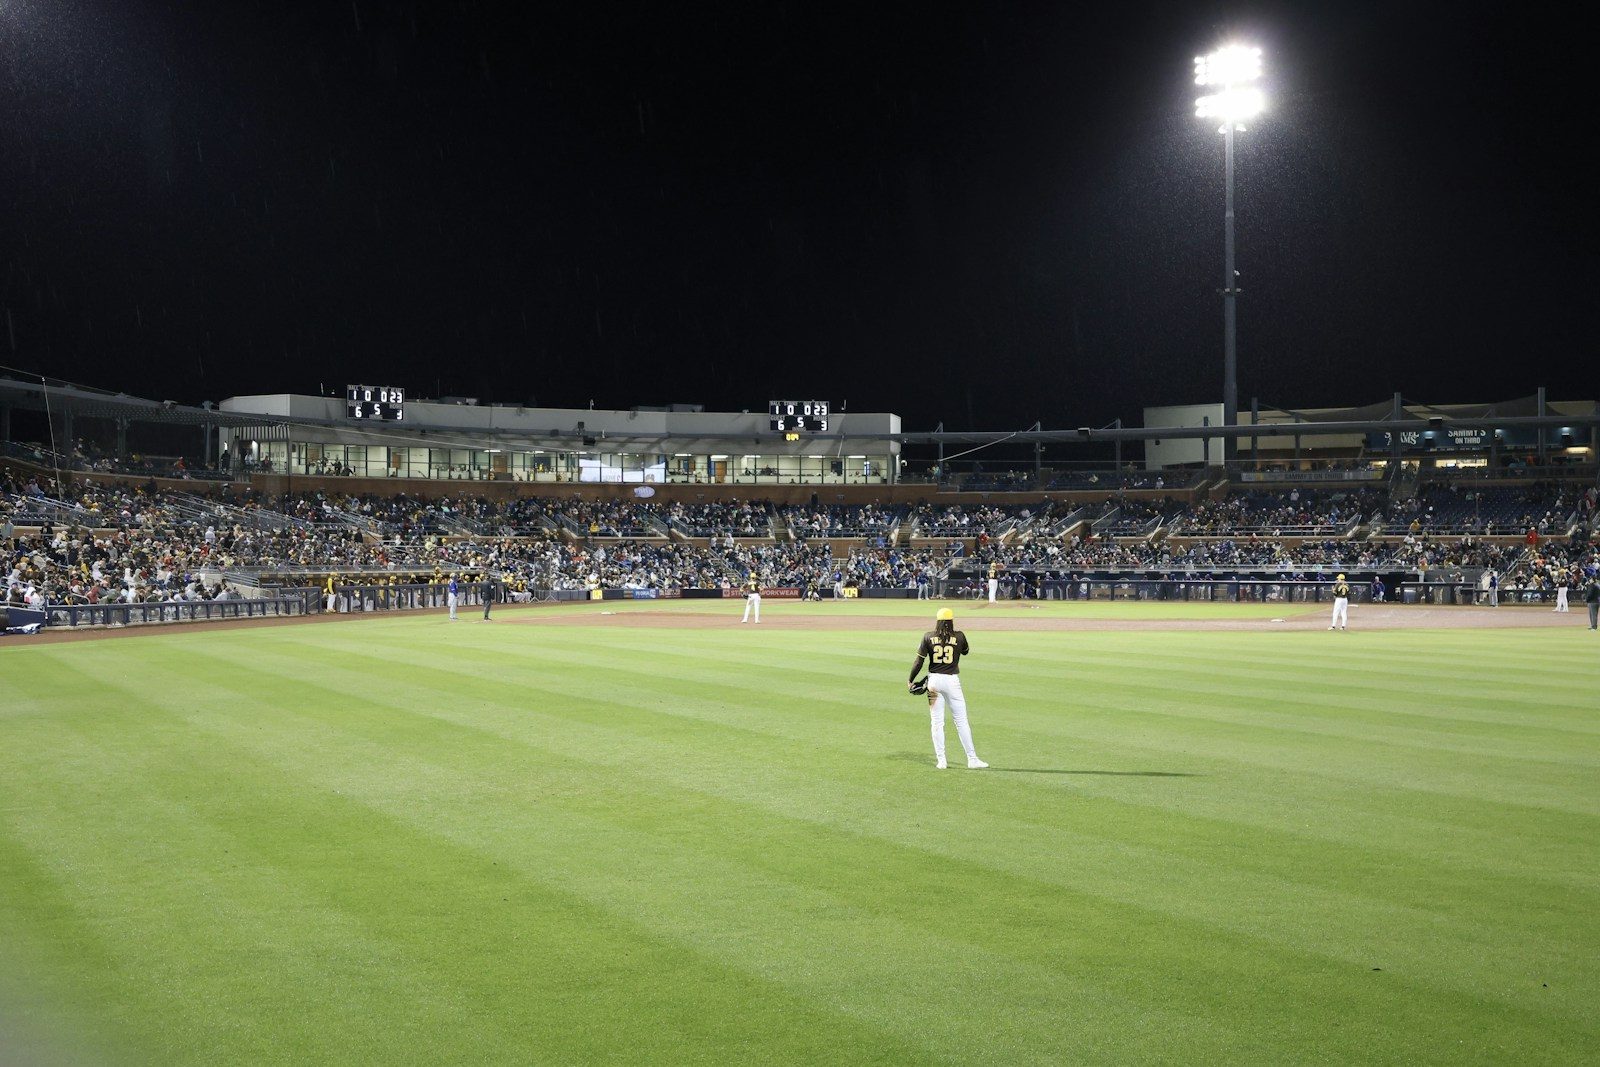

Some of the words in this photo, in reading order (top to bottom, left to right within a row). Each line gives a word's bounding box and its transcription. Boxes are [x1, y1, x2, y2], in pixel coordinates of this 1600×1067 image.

[354, 390, 357, 400] 1
[365, 390, 371, 402] 0
[381, 391, 387, 402] 0
[390, 391, 402, 404] 23
[355, 406, 362, 418] 6
[374, 404, 380, 415] 5
[397, 410, 402, 420] 3
[776, 405, 779, 414] 1
[787, 404, 794, 416] 0
[804, 404, 811, 416] 0
[814, 405, 827, 416] 23
[778, 420, 785, 430] 6
[797, 416, 804, 428] 5
[821, 420, 827, 431] 3
[933, 645, 954, 664] 23
